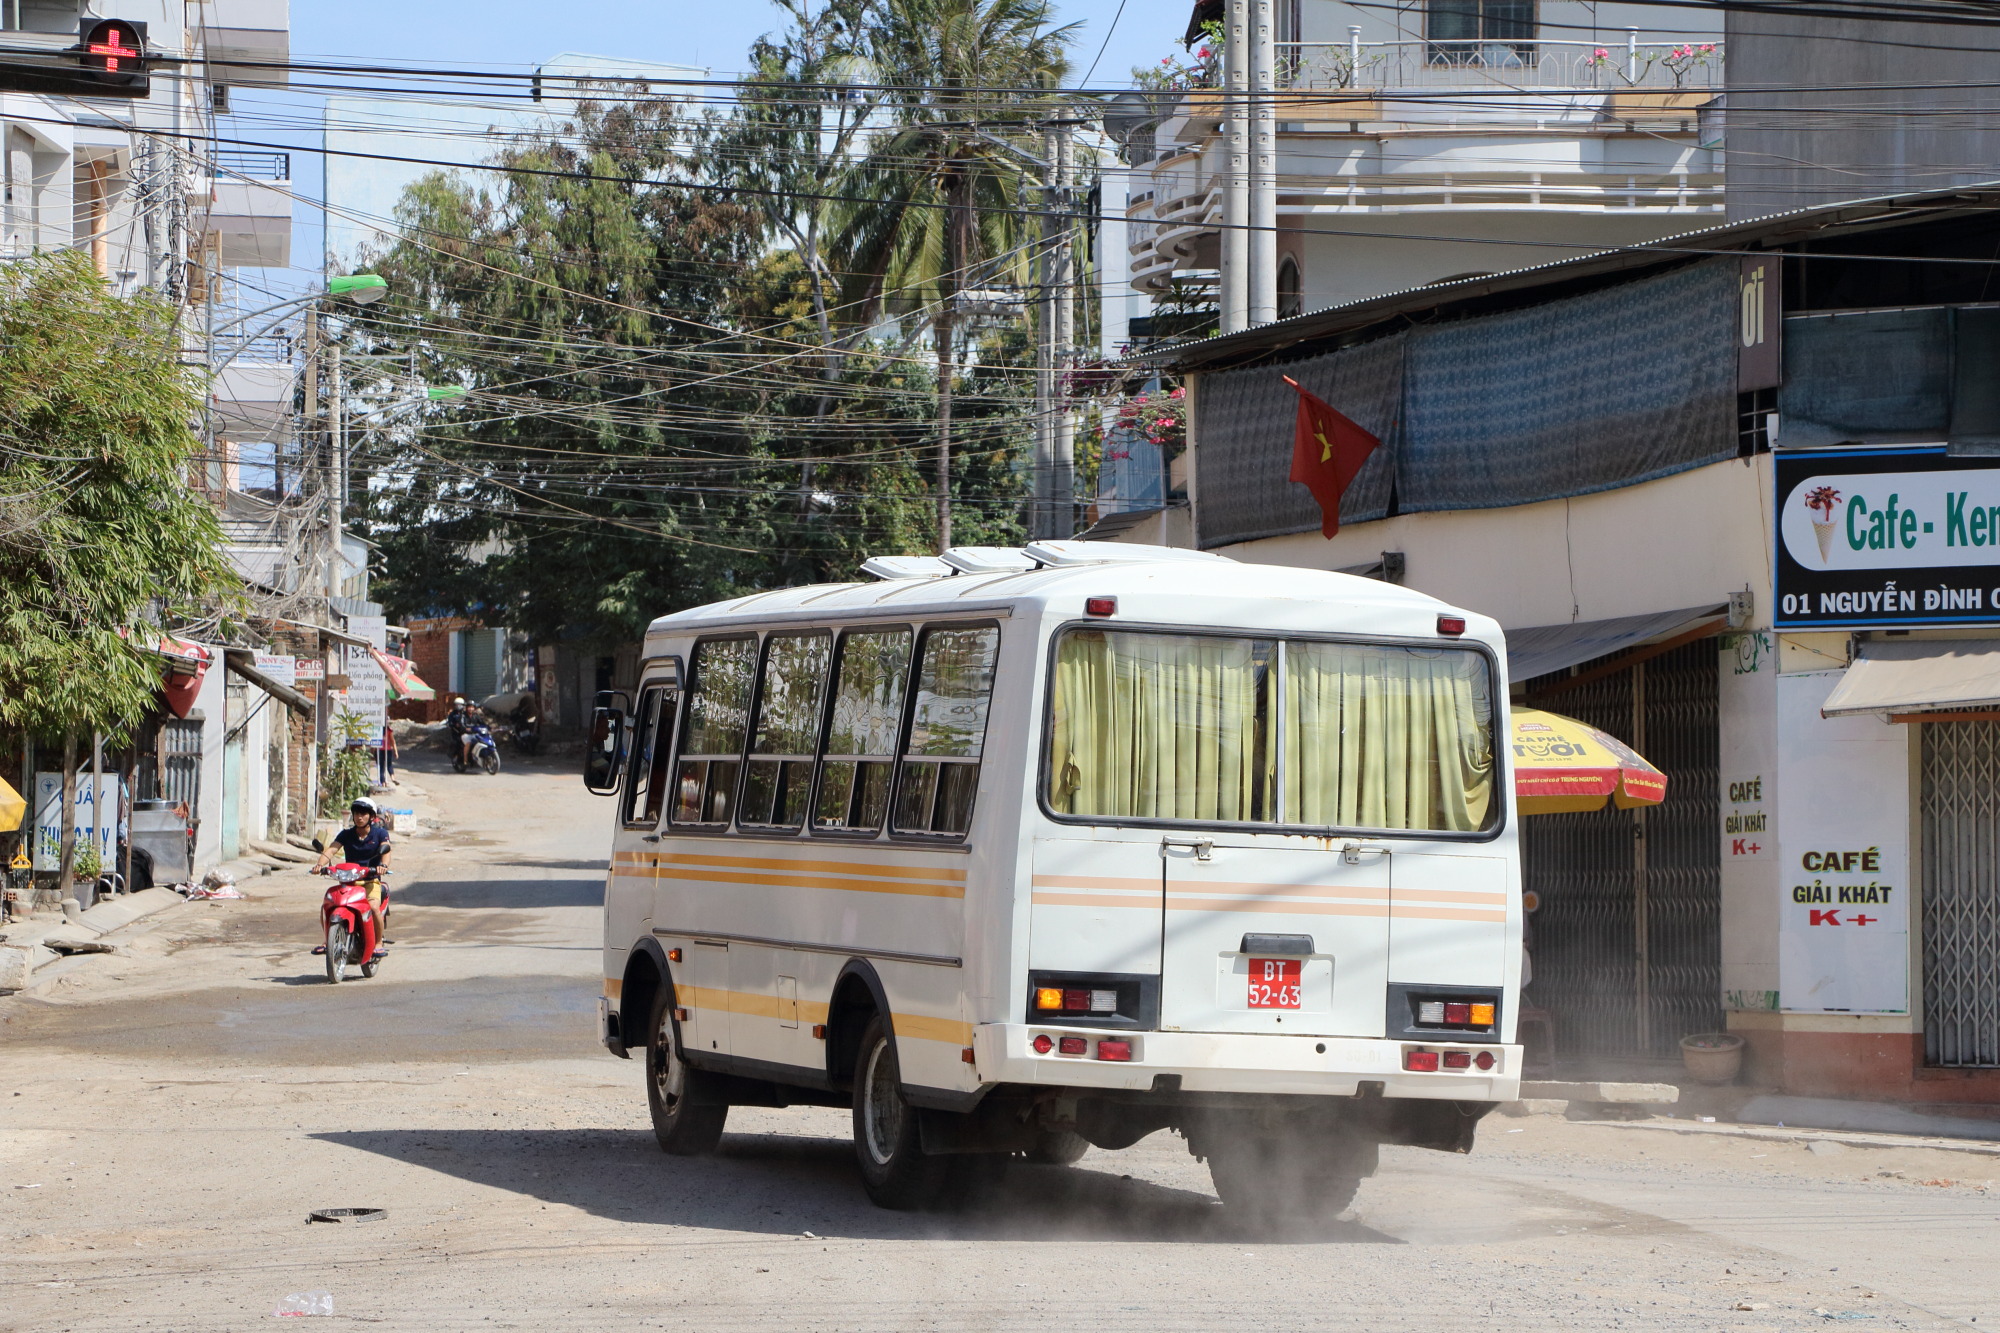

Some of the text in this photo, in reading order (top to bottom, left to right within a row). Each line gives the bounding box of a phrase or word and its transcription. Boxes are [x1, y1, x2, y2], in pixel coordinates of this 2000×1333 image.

[1781, 593, 1811, 615] 01
[1820, 580, 1916, 614] NGUYỄN
[1923, 584, 1982, 611] ĐÌNH
[1729, 776, 1762, 803] CAFÉ
[1726, 809, 1767, 834] GIẢI KHÁT
[1802, 847, 1881, 874] CAFÉ
[1792, 879, 1892, 904] GIẢI KHÁT
[1264, 960, 1286, 982] BT
[1249, 984, 1301, 1006] 52-63
